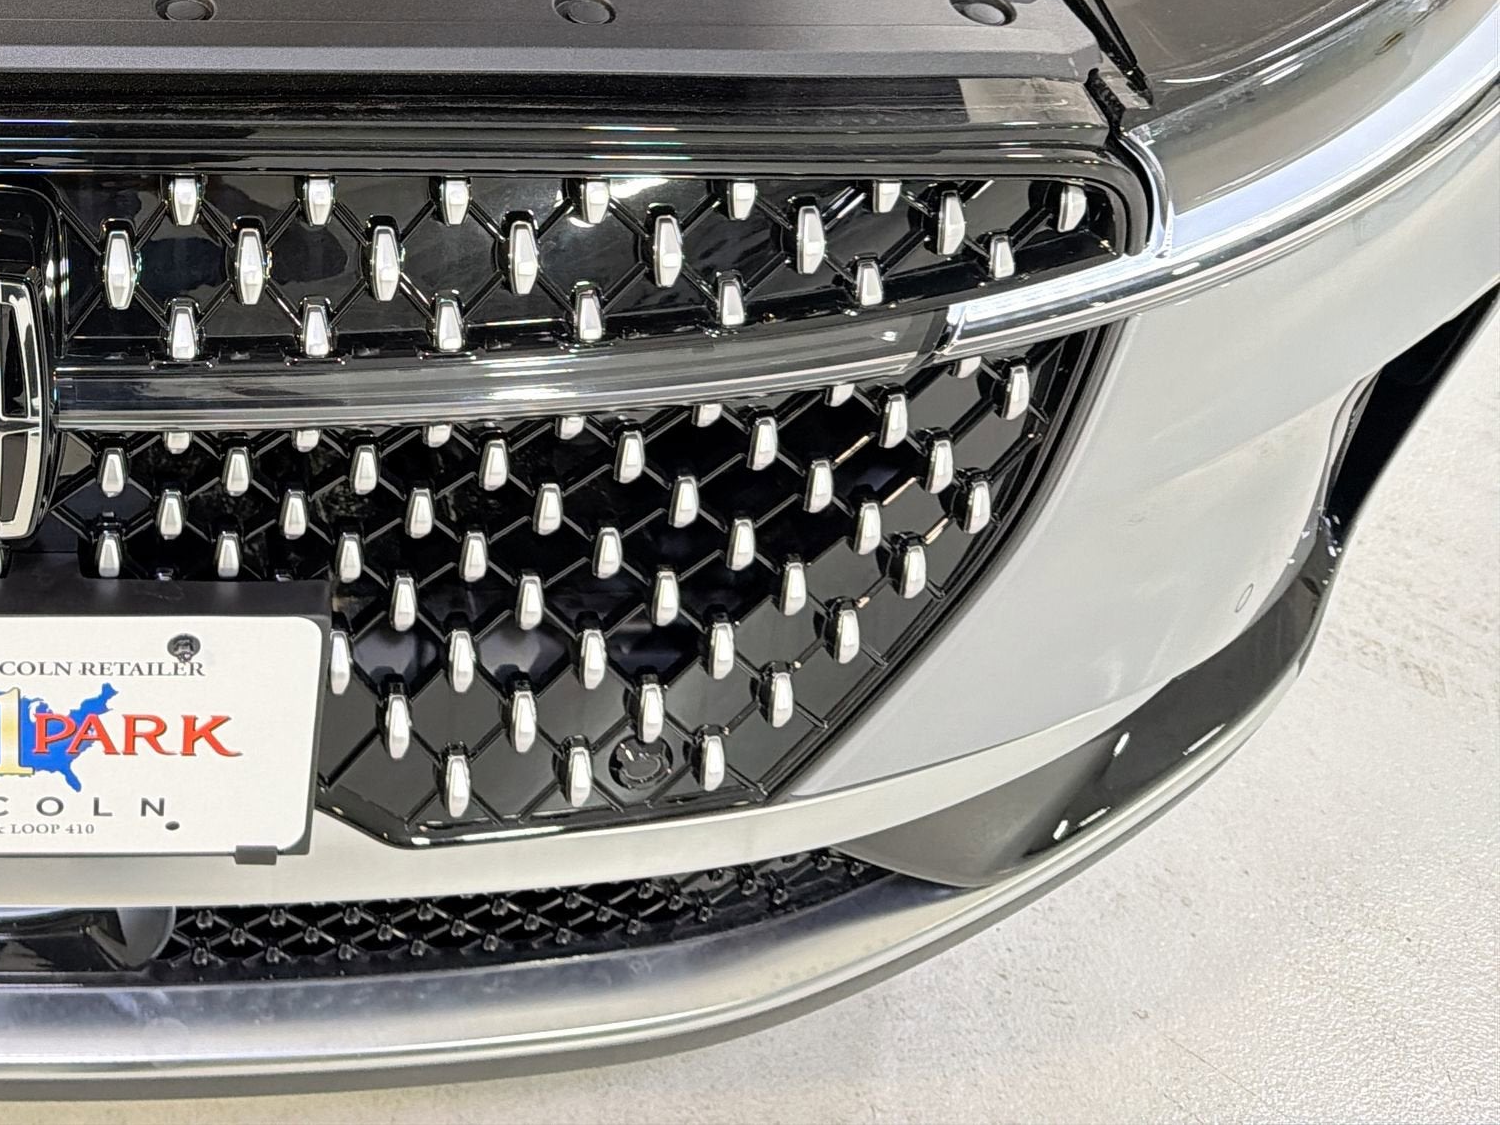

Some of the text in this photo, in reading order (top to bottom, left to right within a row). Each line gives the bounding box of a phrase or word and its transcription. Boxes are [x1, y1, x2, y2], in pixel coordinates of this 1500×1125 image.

[80, 661, 205, 676] RETAILER
[33, 713, 243, 757] PARK
[11, 823, 60, 834] LOOP
[65, 823, 95, 834] 410
